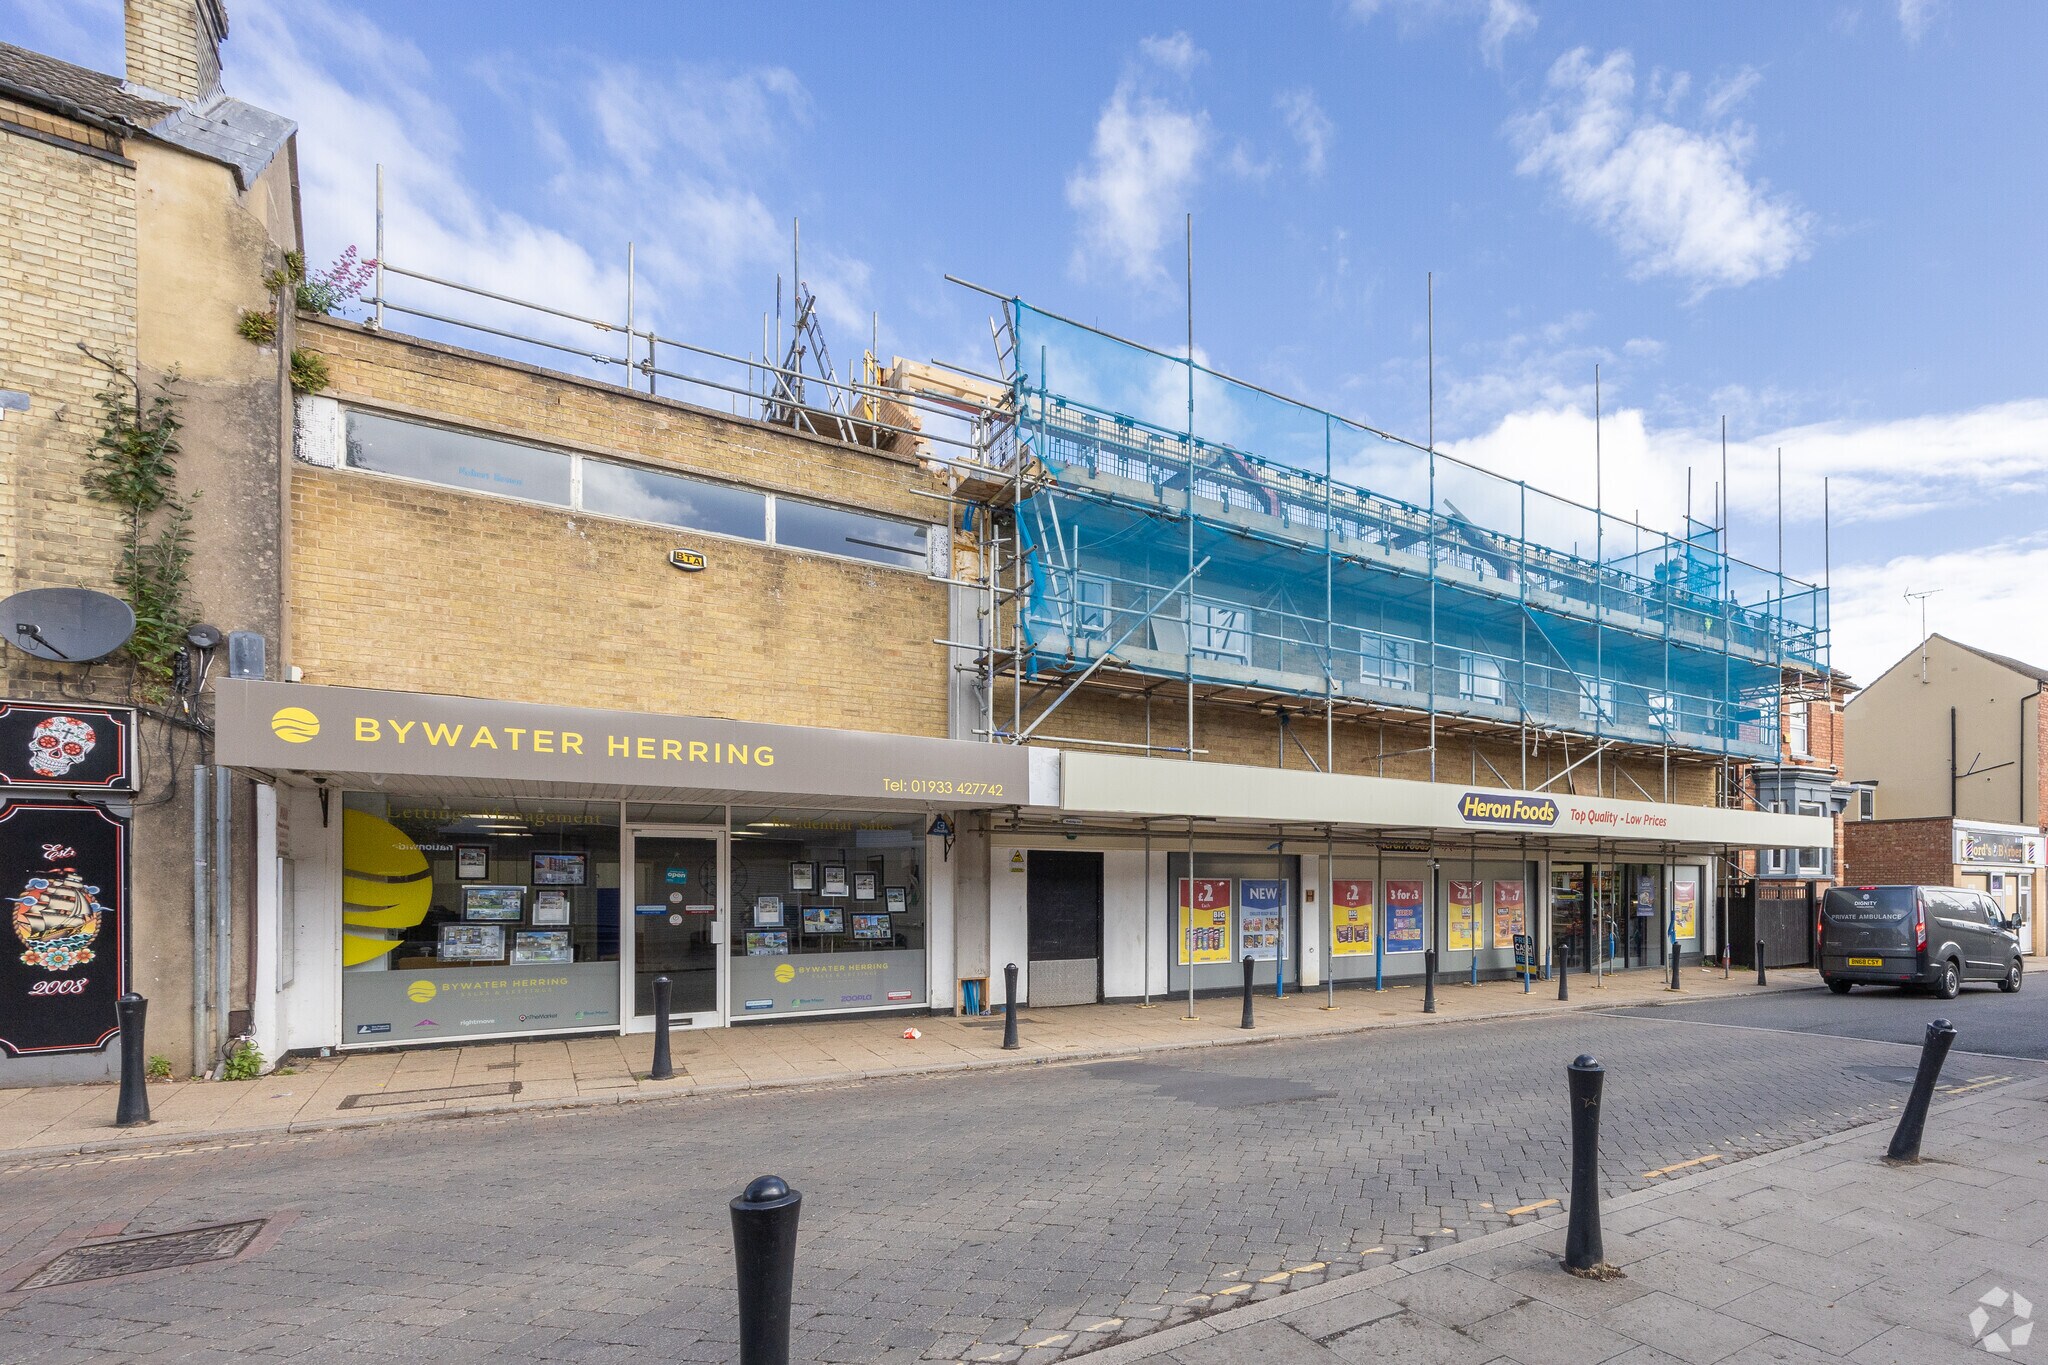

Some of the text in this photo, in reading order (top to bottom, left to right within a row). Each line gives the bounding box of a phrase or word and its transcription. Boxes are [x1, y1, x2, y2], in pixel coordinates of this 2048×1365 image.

[676, 552, 701, 566] BTA
[355, 717, 775, 767] BYWATER HERRING
[883, 778, 1003, 796] Tel: 01933 427742
[1464, 796, 1555, 821] Heron Foods
[1570, 808, 1586, 824] Top
[1588, 810, 1619, 827] Quality
[1626, 812, 1641, 825] Low
[1643, 814, 1667, 827] Prices
[1972, 843, 1992, 856] ord's
[1198, 884, 1214, 902] £2
[1250, 888, 1278, 900] NEW
[1346, 885, 1359, 901] £2
[1390, 888, 1419, 900] 3 for £3
[1500, 890, 1506, 901] 3
[799, 963, 889, 973] BYWATER HERRING
[29, 977, 89, 995] 2008
[442, 978, 569, 991] BYWATER HERRING
[460, 1018, 495, 1026] rightmove
